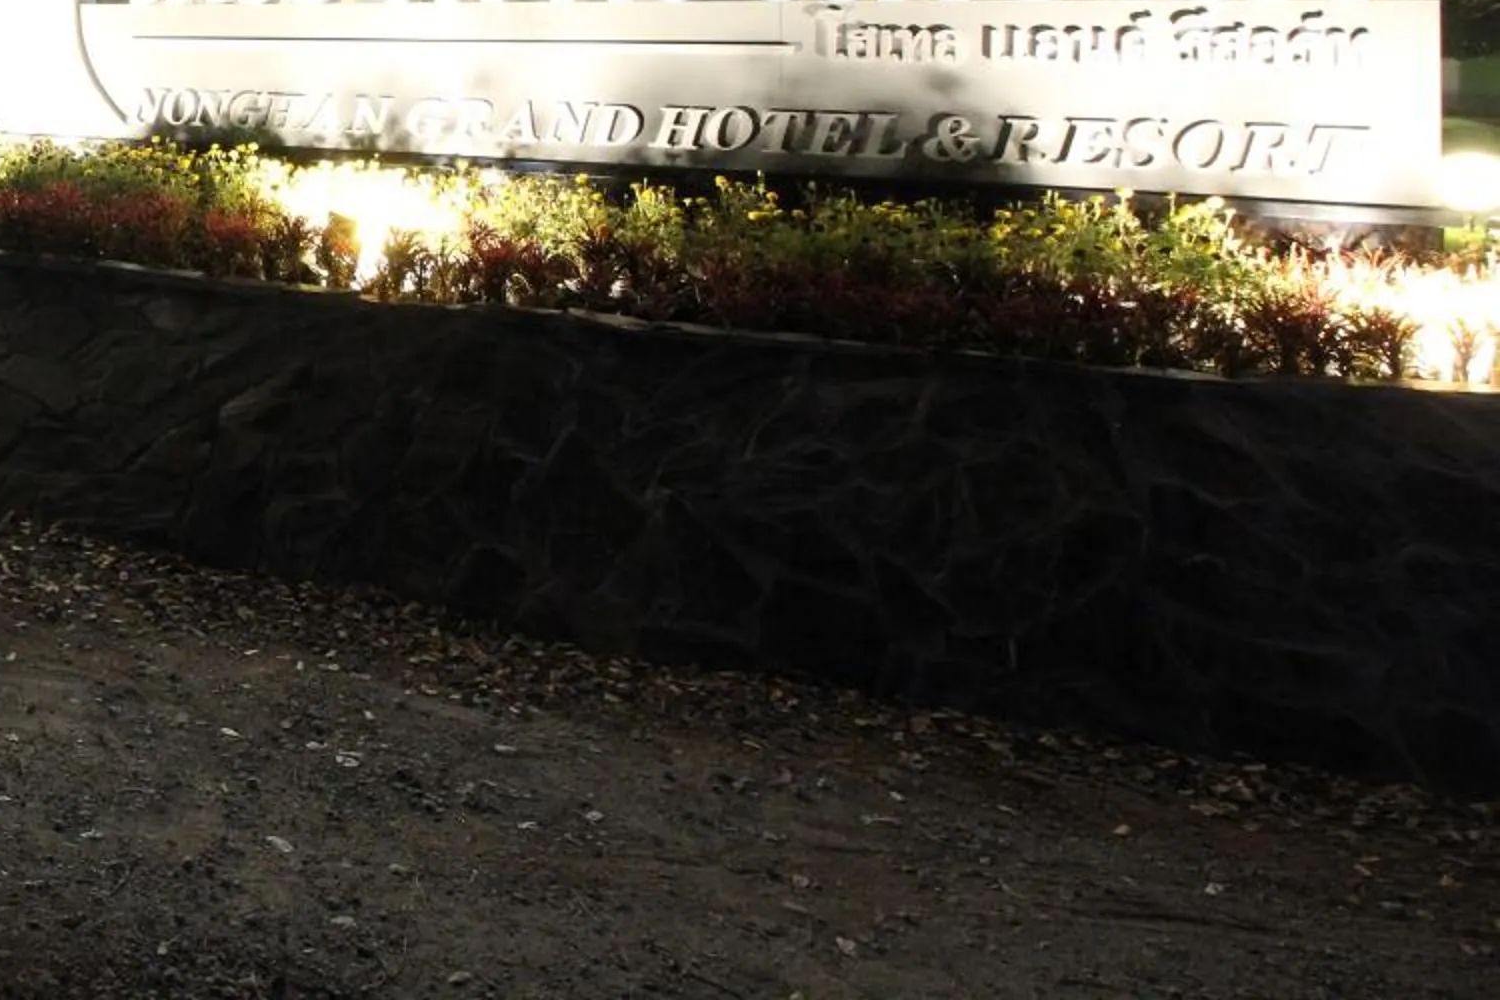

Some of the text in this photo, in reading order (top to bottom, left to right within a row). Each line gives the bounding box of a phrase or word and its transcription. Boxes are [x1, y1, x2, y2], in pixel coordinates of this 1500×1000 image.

[406, 98, 646, 147] GRAND
[648, 104, 908, 161] HOTEL
[922, 113, 981, 164] &
[992, 112, 1373, 176] RESORT
